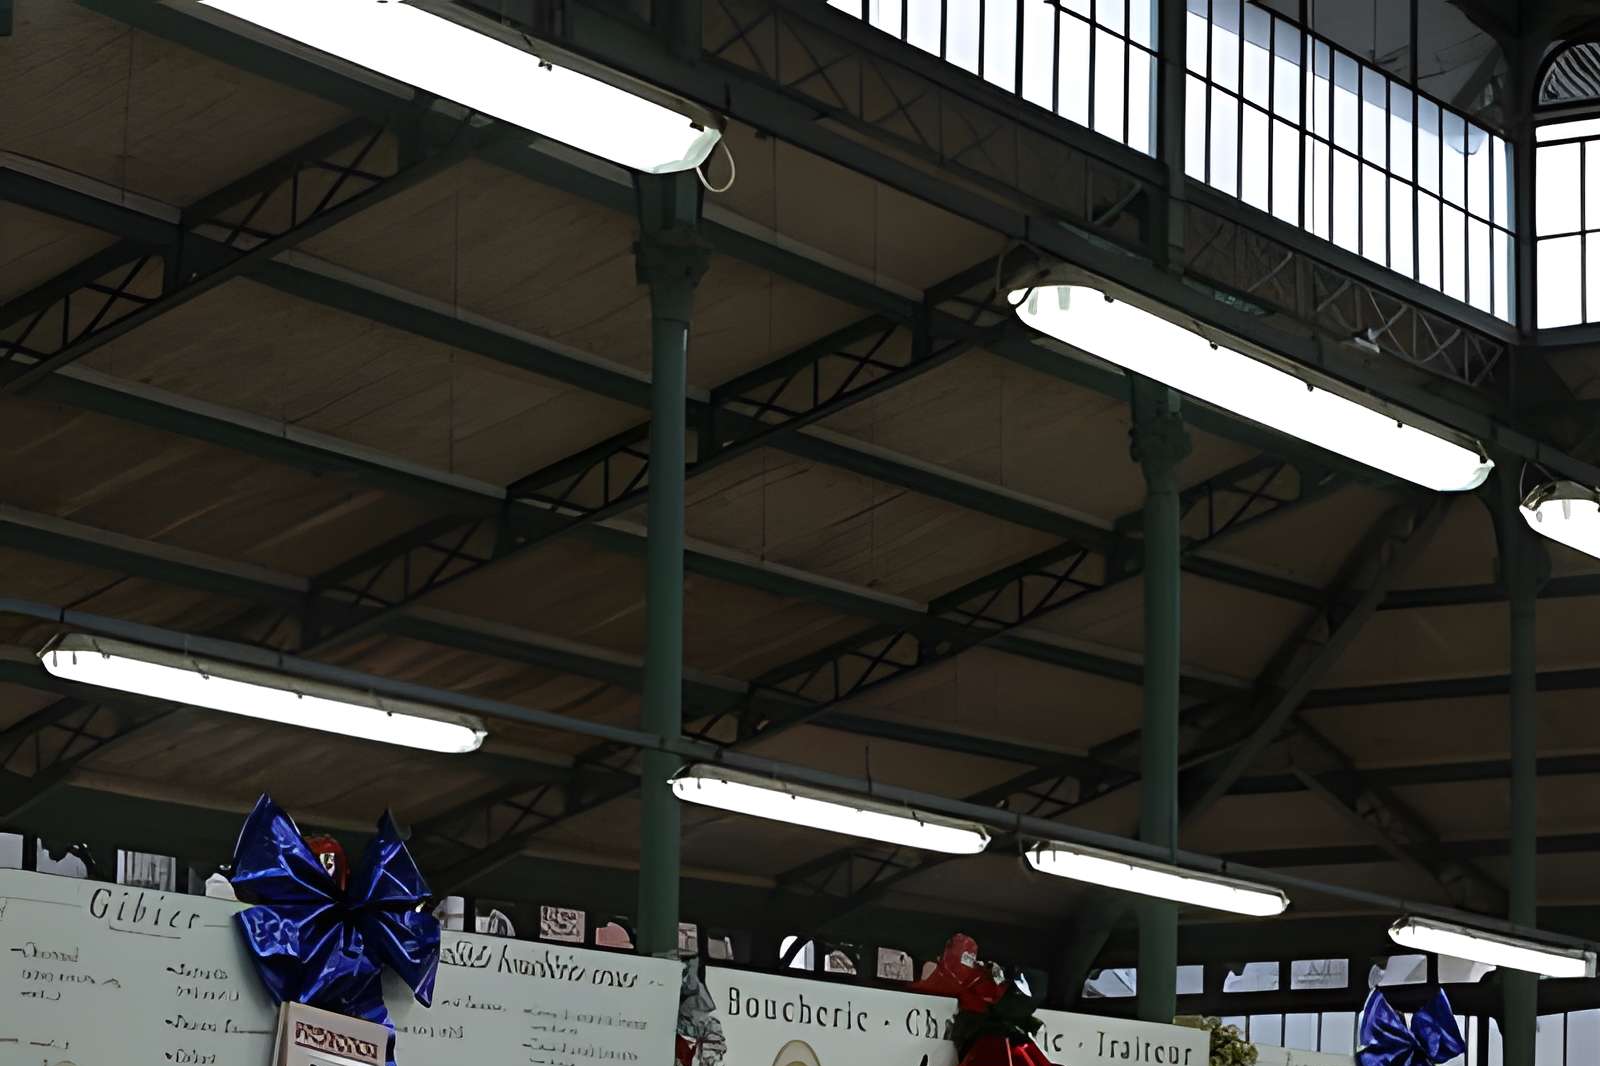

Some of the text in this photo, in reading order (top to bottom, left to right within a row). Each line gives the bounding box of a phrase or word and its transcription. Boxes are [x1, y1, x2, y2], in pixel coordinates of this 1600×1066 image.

[89, 886, 202, 931] Gibier
[727, 986, 868, 1032] Boucherie
[1096, 1031, 1193, 1066] Traiteur
